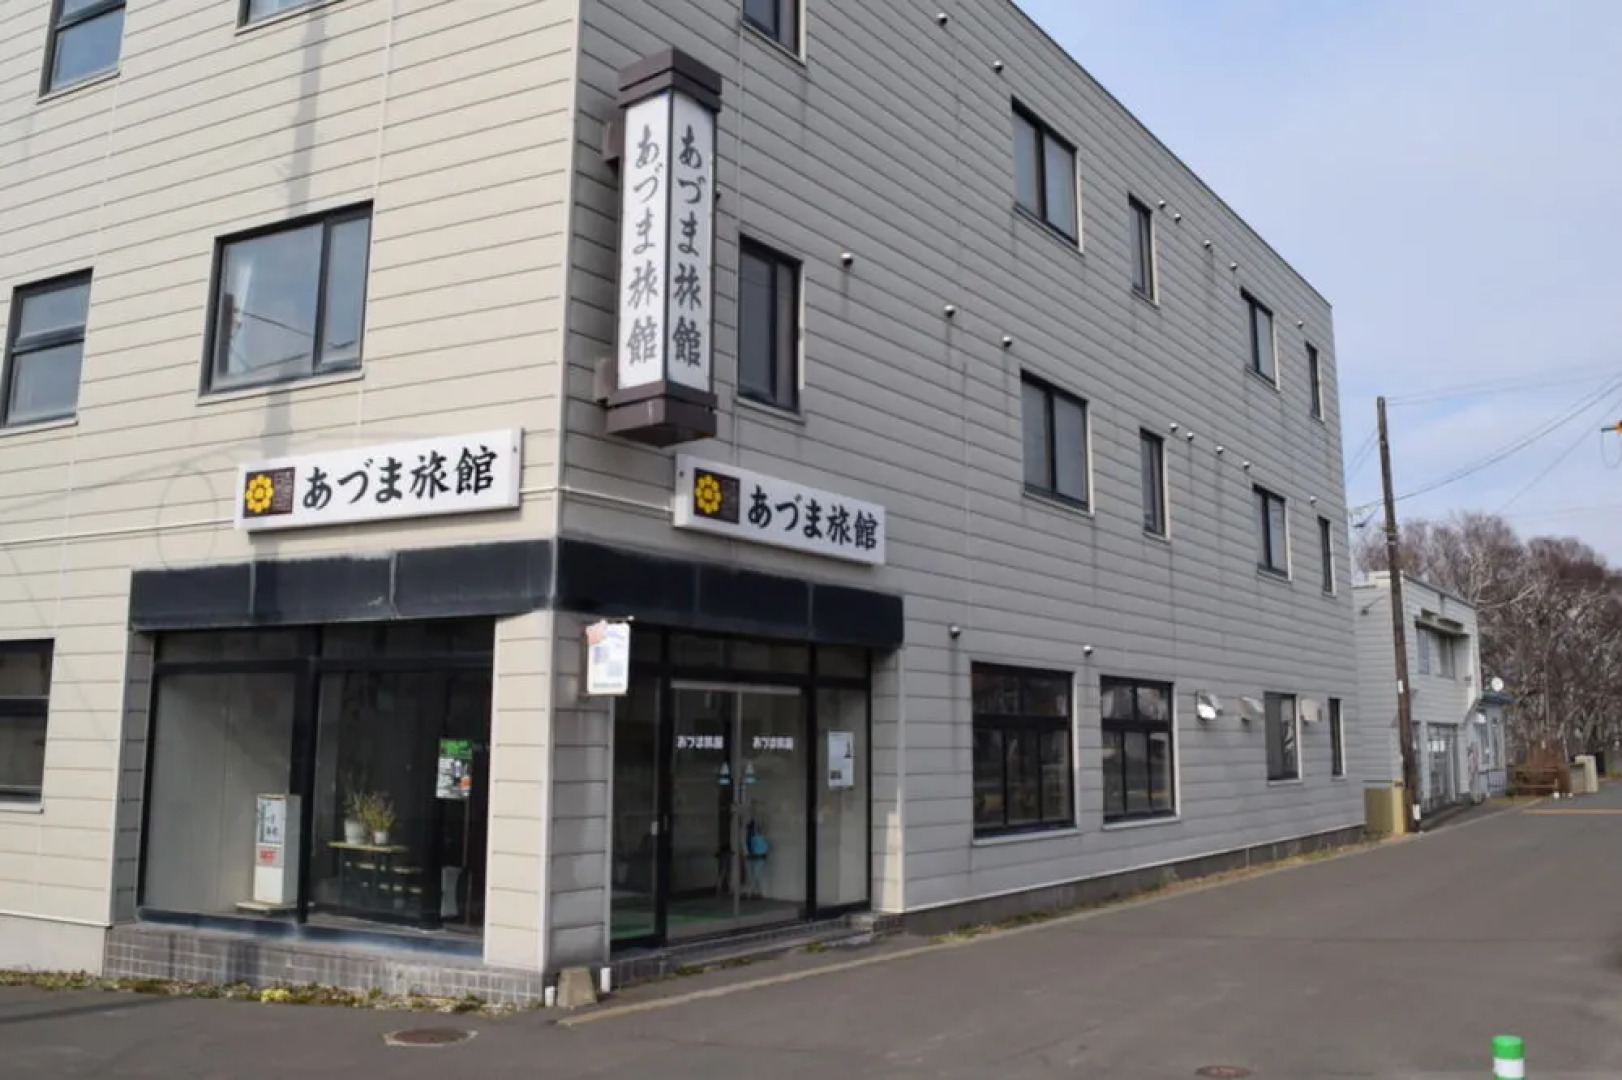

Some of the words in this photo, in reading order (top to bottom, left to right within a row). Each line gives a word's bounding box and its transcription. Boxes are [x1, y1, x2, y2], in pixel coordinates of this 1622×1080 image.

[626, 123, 664, 367] あづま旅館
[671, 123, 706, 367] あづま旅館
[302, 445, 498, 511] あづま旅館
[747, 484, 879, 551] あづま旅館
